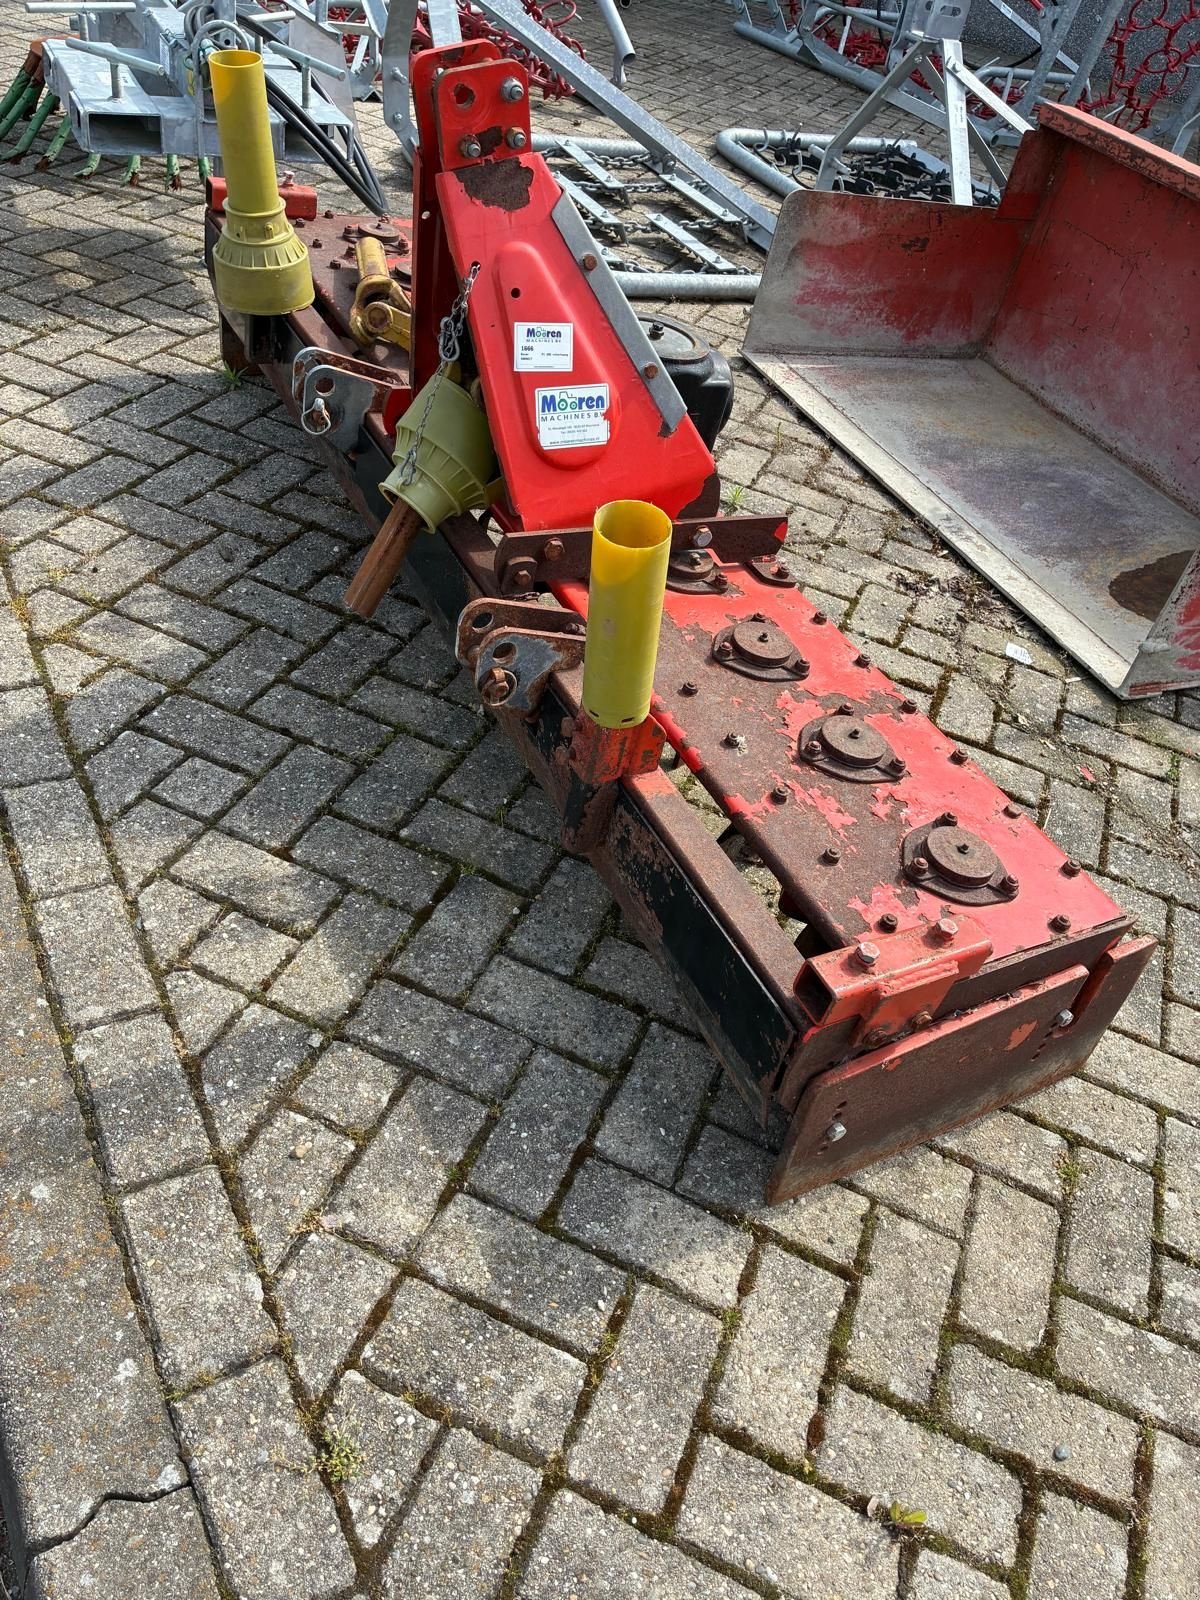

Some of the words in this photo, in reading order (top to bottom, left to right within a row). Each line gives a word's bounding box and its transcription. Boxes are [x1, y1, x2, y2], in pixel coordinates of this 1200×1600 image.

[526, 327, 562, 338] Mooren
[541, 394, 605, 413] Mooren
[541, 412, 591, 422] MACHINES
